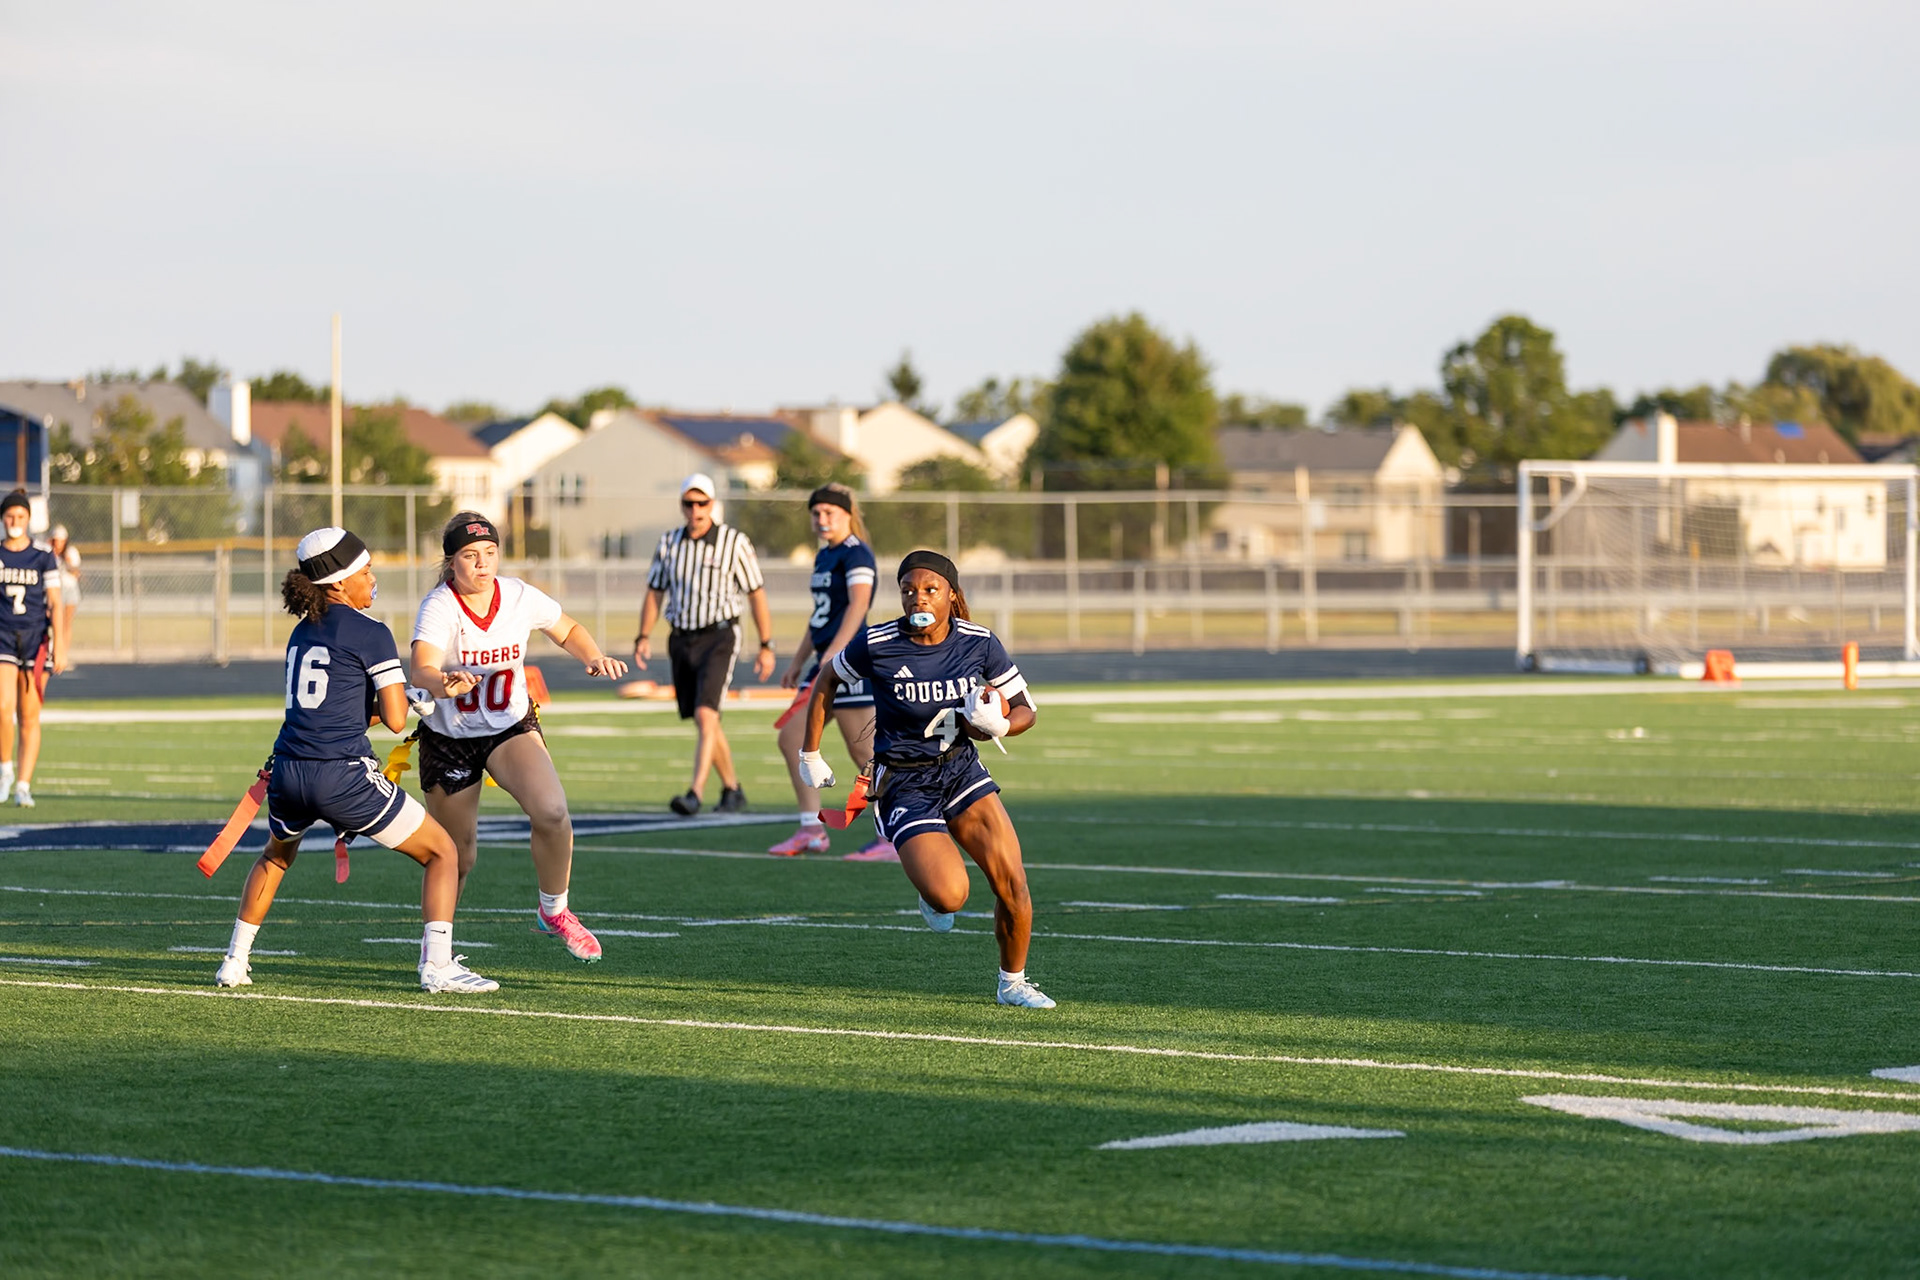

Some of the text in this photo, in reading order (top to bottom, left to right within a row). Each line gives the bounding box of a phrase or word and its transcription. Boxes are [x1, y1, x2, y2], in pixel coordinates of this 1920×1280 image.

[6, 585, 27, 615] 7
[461, 644, 520, 666] TIGERS
[286, 645, 331, 709] 16
[924, 707, 960, 752] 4
